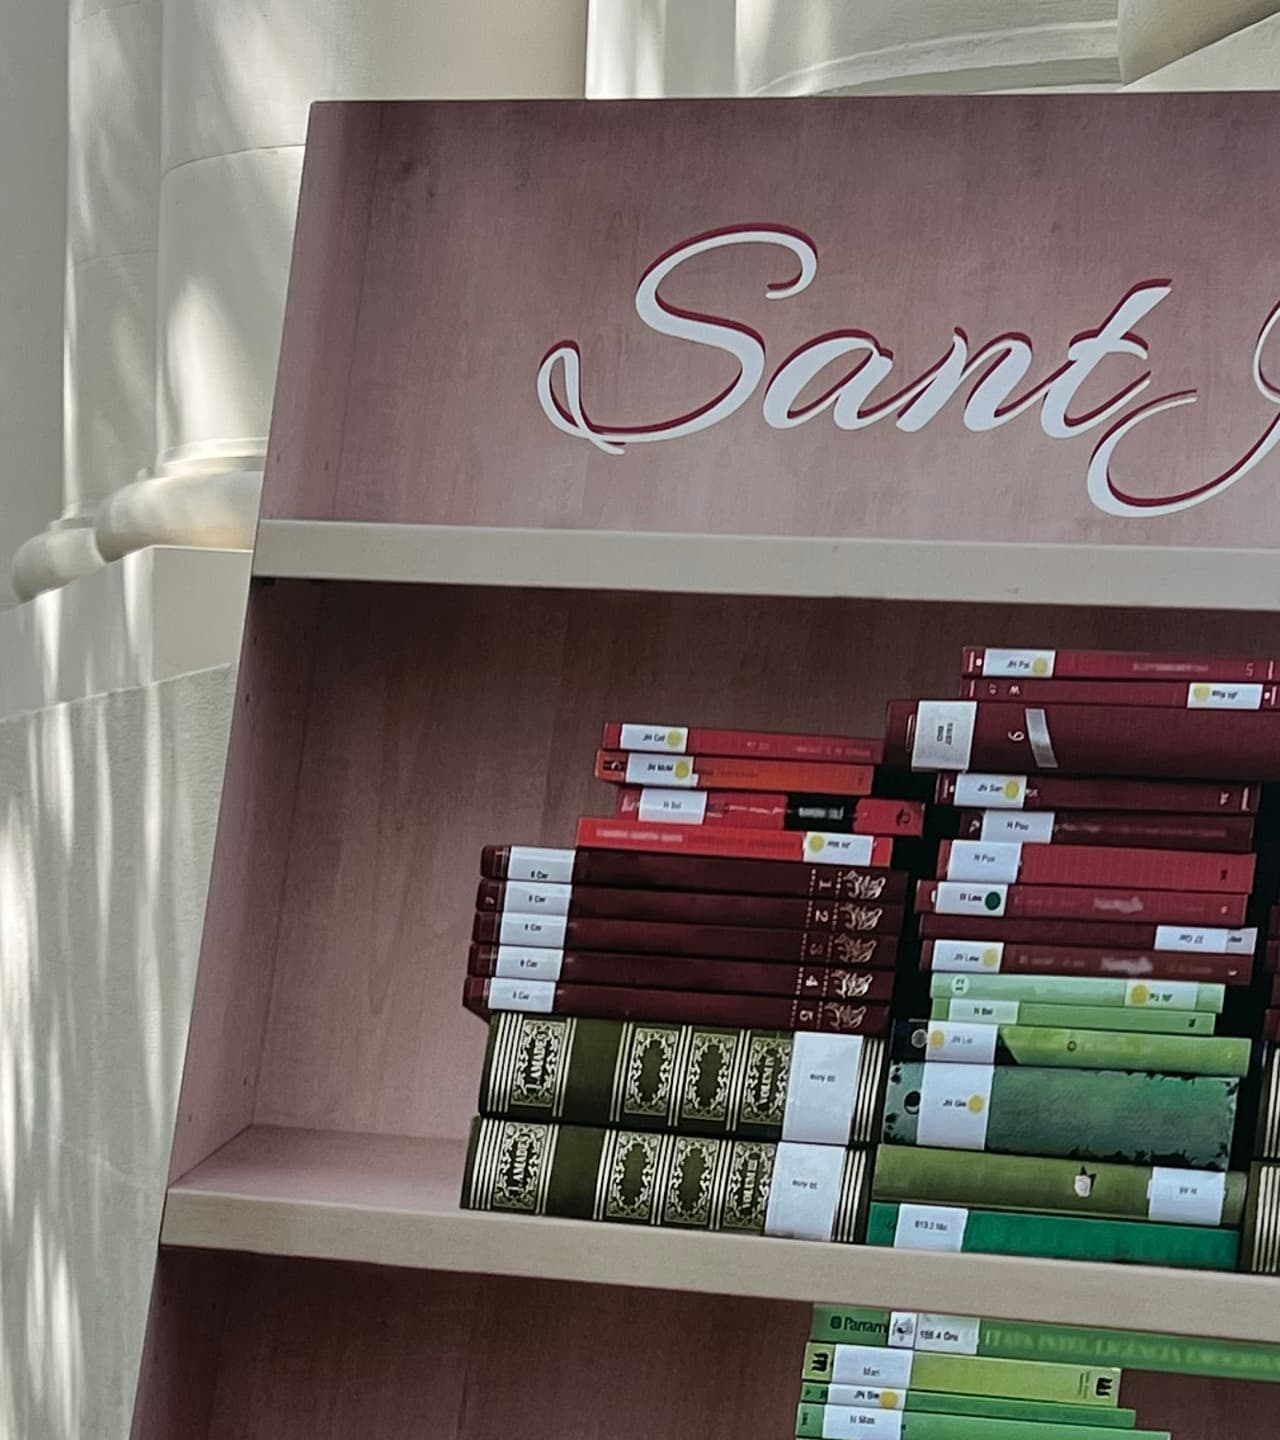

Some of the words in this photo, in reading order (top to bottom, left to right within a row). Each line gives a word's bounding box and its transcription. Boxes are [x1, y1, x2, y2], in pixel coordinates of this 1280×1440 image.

[537, 223, 1173, 455] Sant
[815, 909, 829, 923] 2
[805, 975, 818, 986] 4
